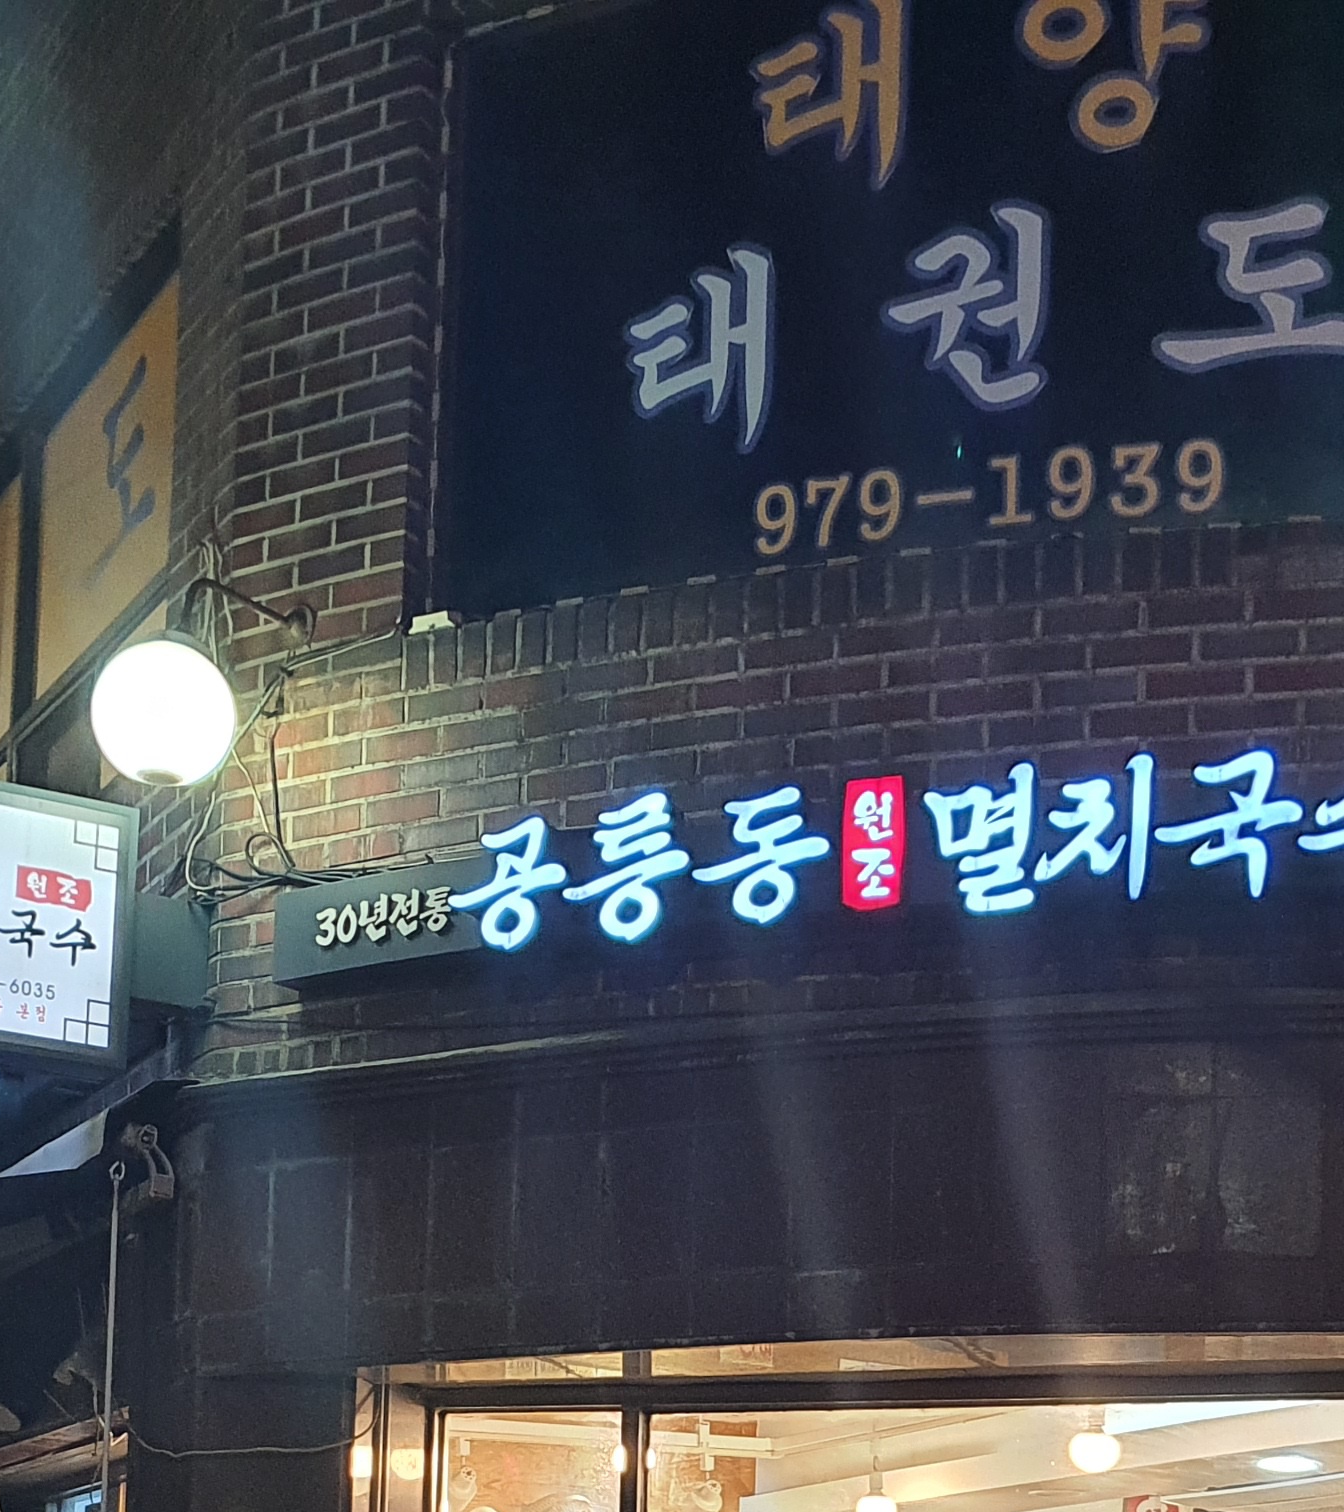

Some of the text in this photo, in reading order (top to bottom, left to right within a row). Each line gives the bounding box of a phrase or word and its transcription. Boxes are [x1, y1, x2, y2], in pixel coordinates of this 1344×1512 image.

[754, 438, 1226, 556] 979-1939
[26, 871, 79, 905] 원조
[316, 885, 452, 947] 30년전통
[449, 786, 830, 951] 공릉동
[851, 790, 895, 898] 원조
[16, 1003, 46, 1022] 본점
